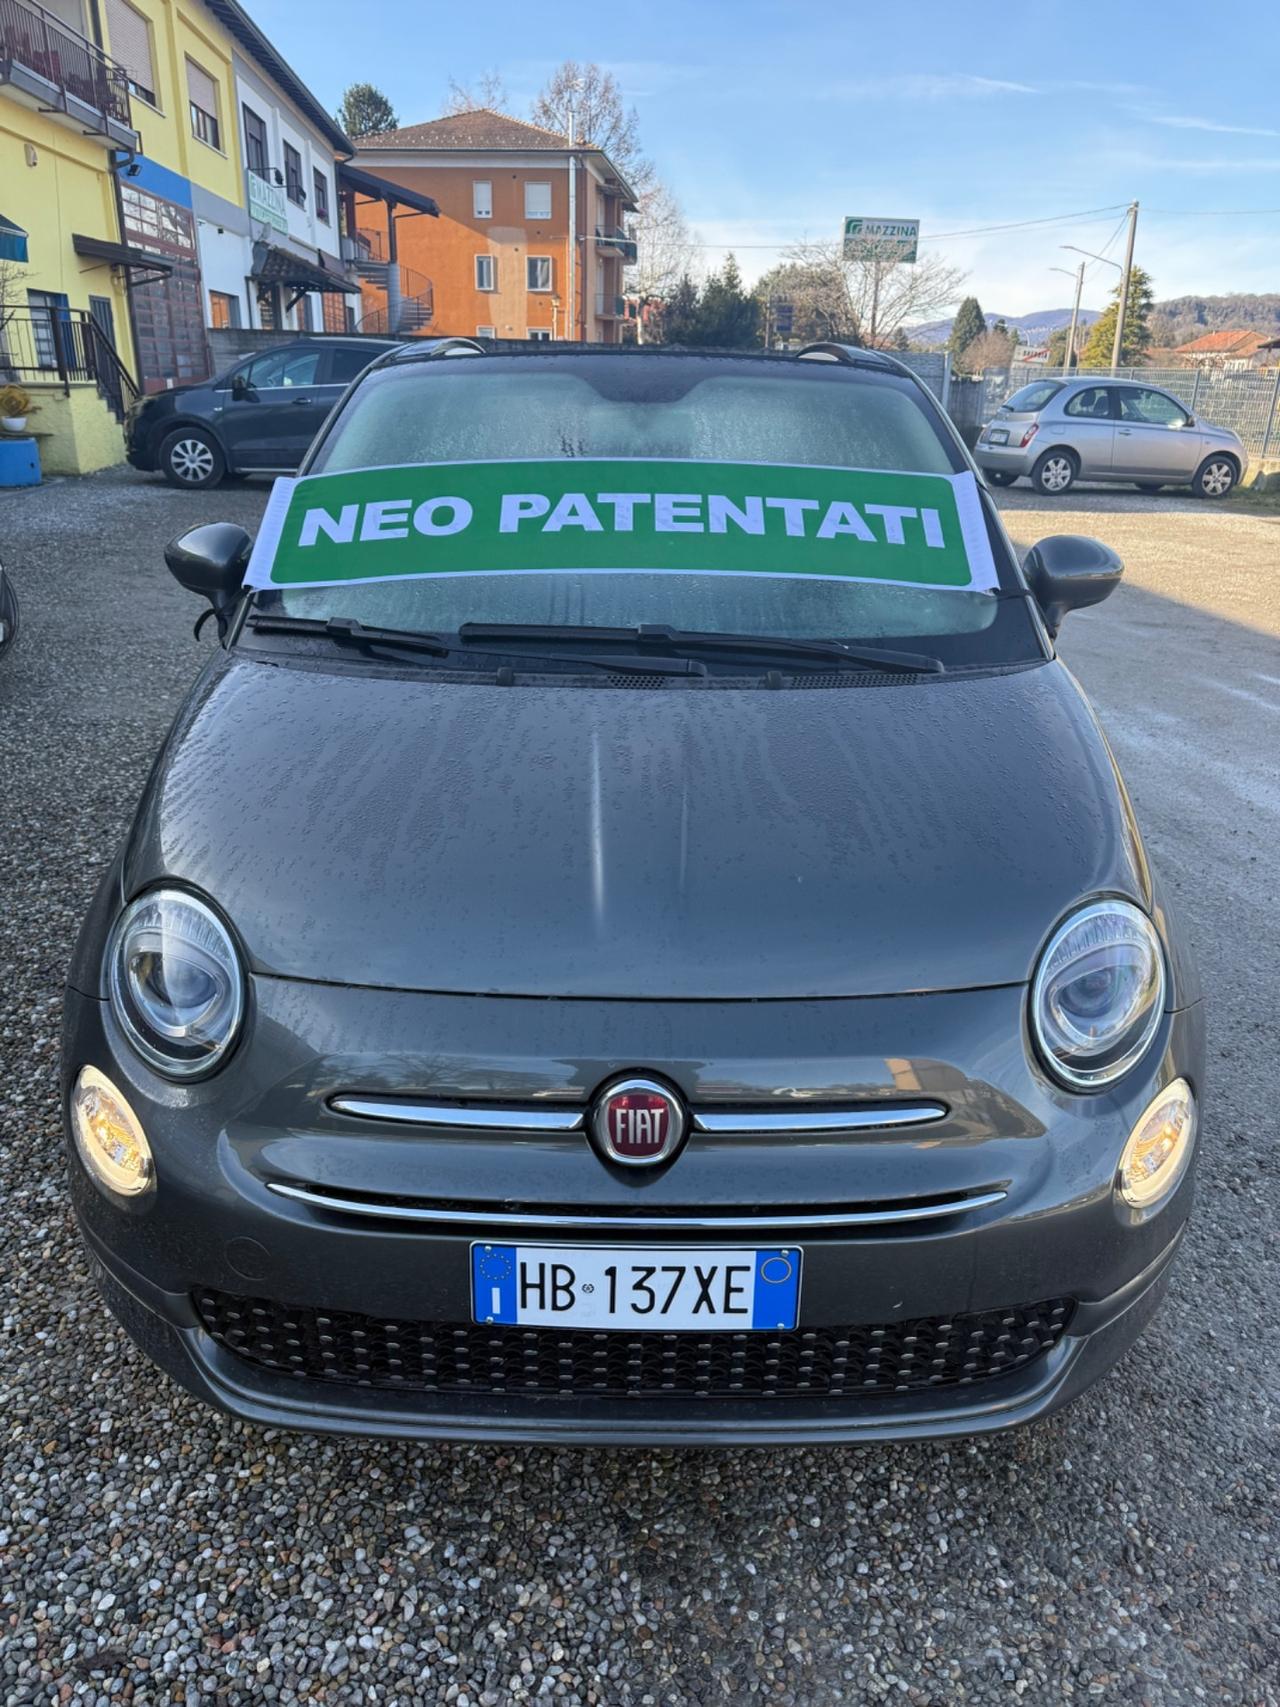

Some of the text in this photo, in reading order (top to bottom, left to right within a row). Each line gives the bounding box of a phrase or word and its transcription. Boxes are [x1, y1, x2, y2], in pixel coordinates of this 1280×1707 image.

[864, 223, 917, 237] MAZZINA
[297, 493, 945, 548] NEO PATENTATI
[616, 1108, 664, 1144] FIAT
[491, 1287, 501, 1315] I
[520, 1262, 751, 1314] HB 137XE
